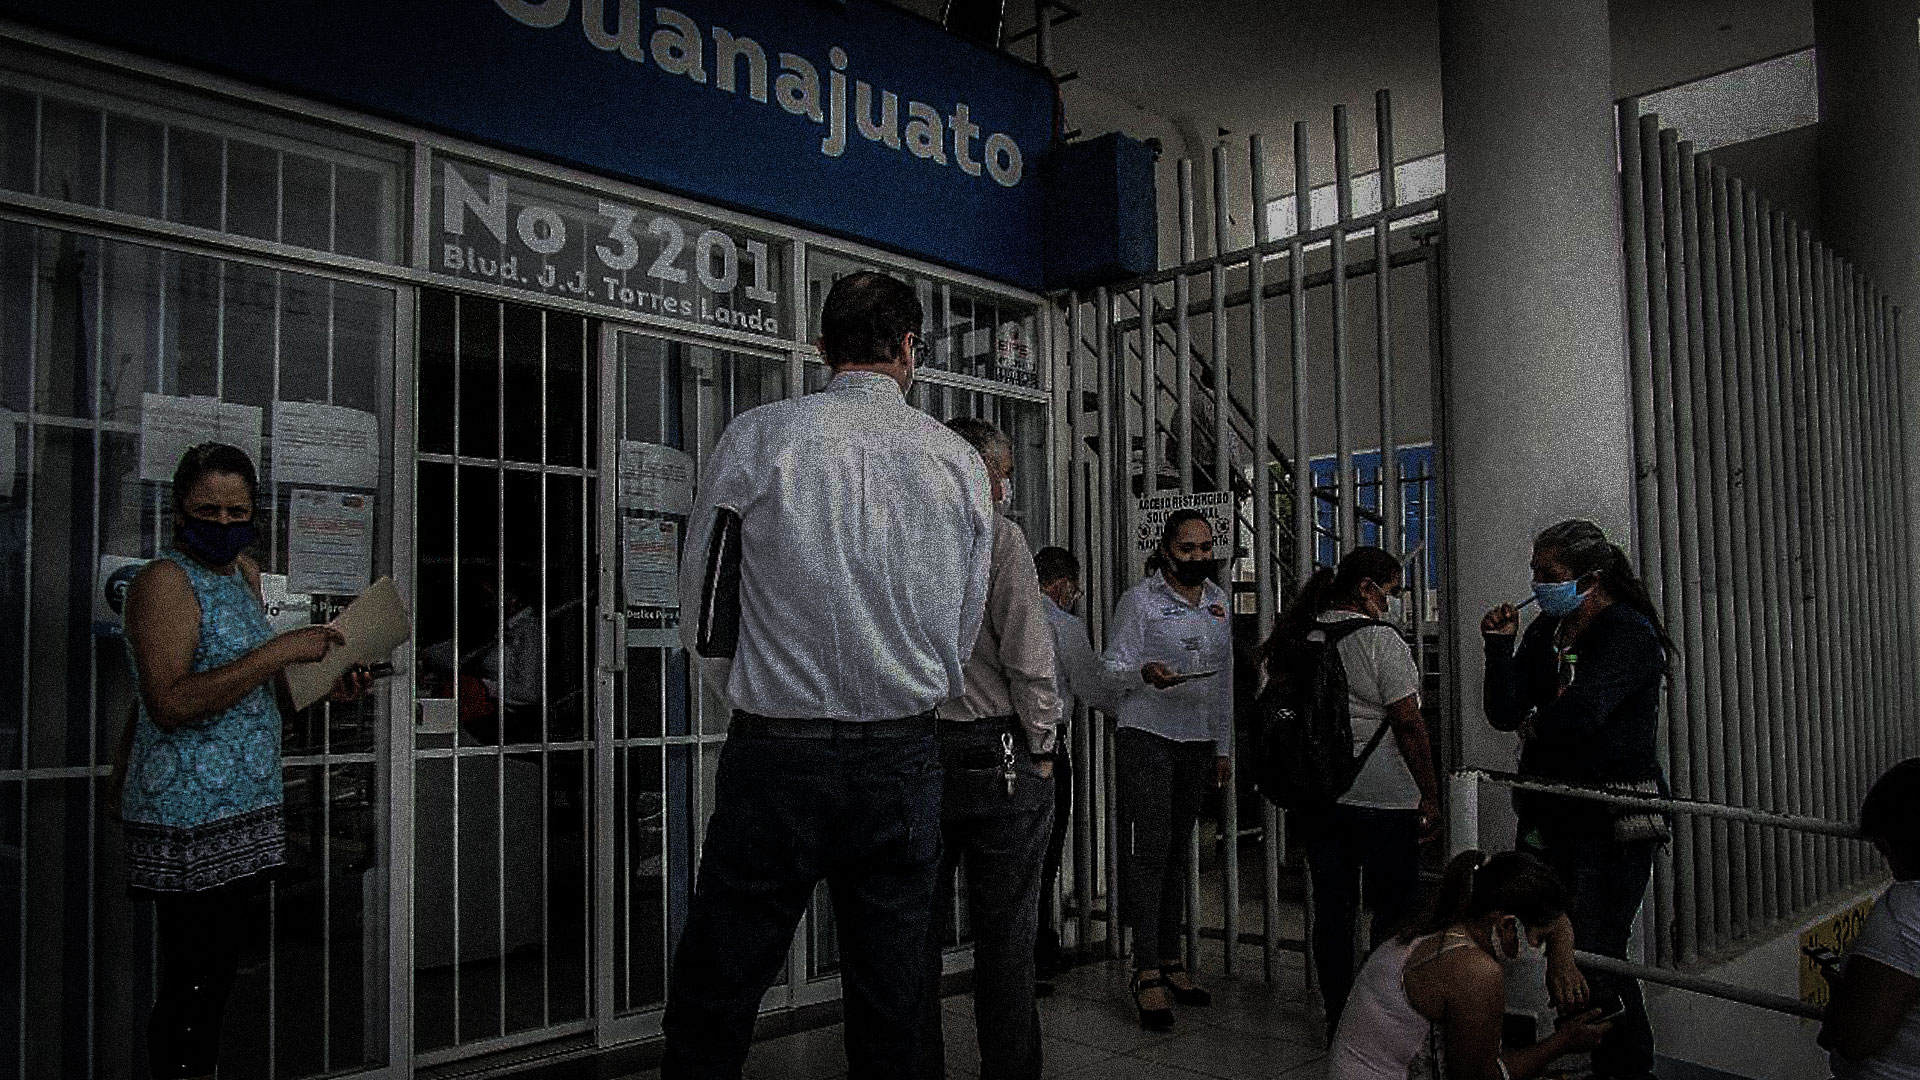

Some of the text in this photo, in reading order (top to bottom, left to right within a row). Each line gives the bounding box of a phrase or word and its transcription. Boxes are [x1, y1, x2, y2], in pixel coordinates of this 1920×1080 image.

[444, 162, 777, 304] No 3201
[444, 243, 528, 283] Blvd.
[603, 276, 692, 316] Torres
[701, 298, 778, 334] Landa
